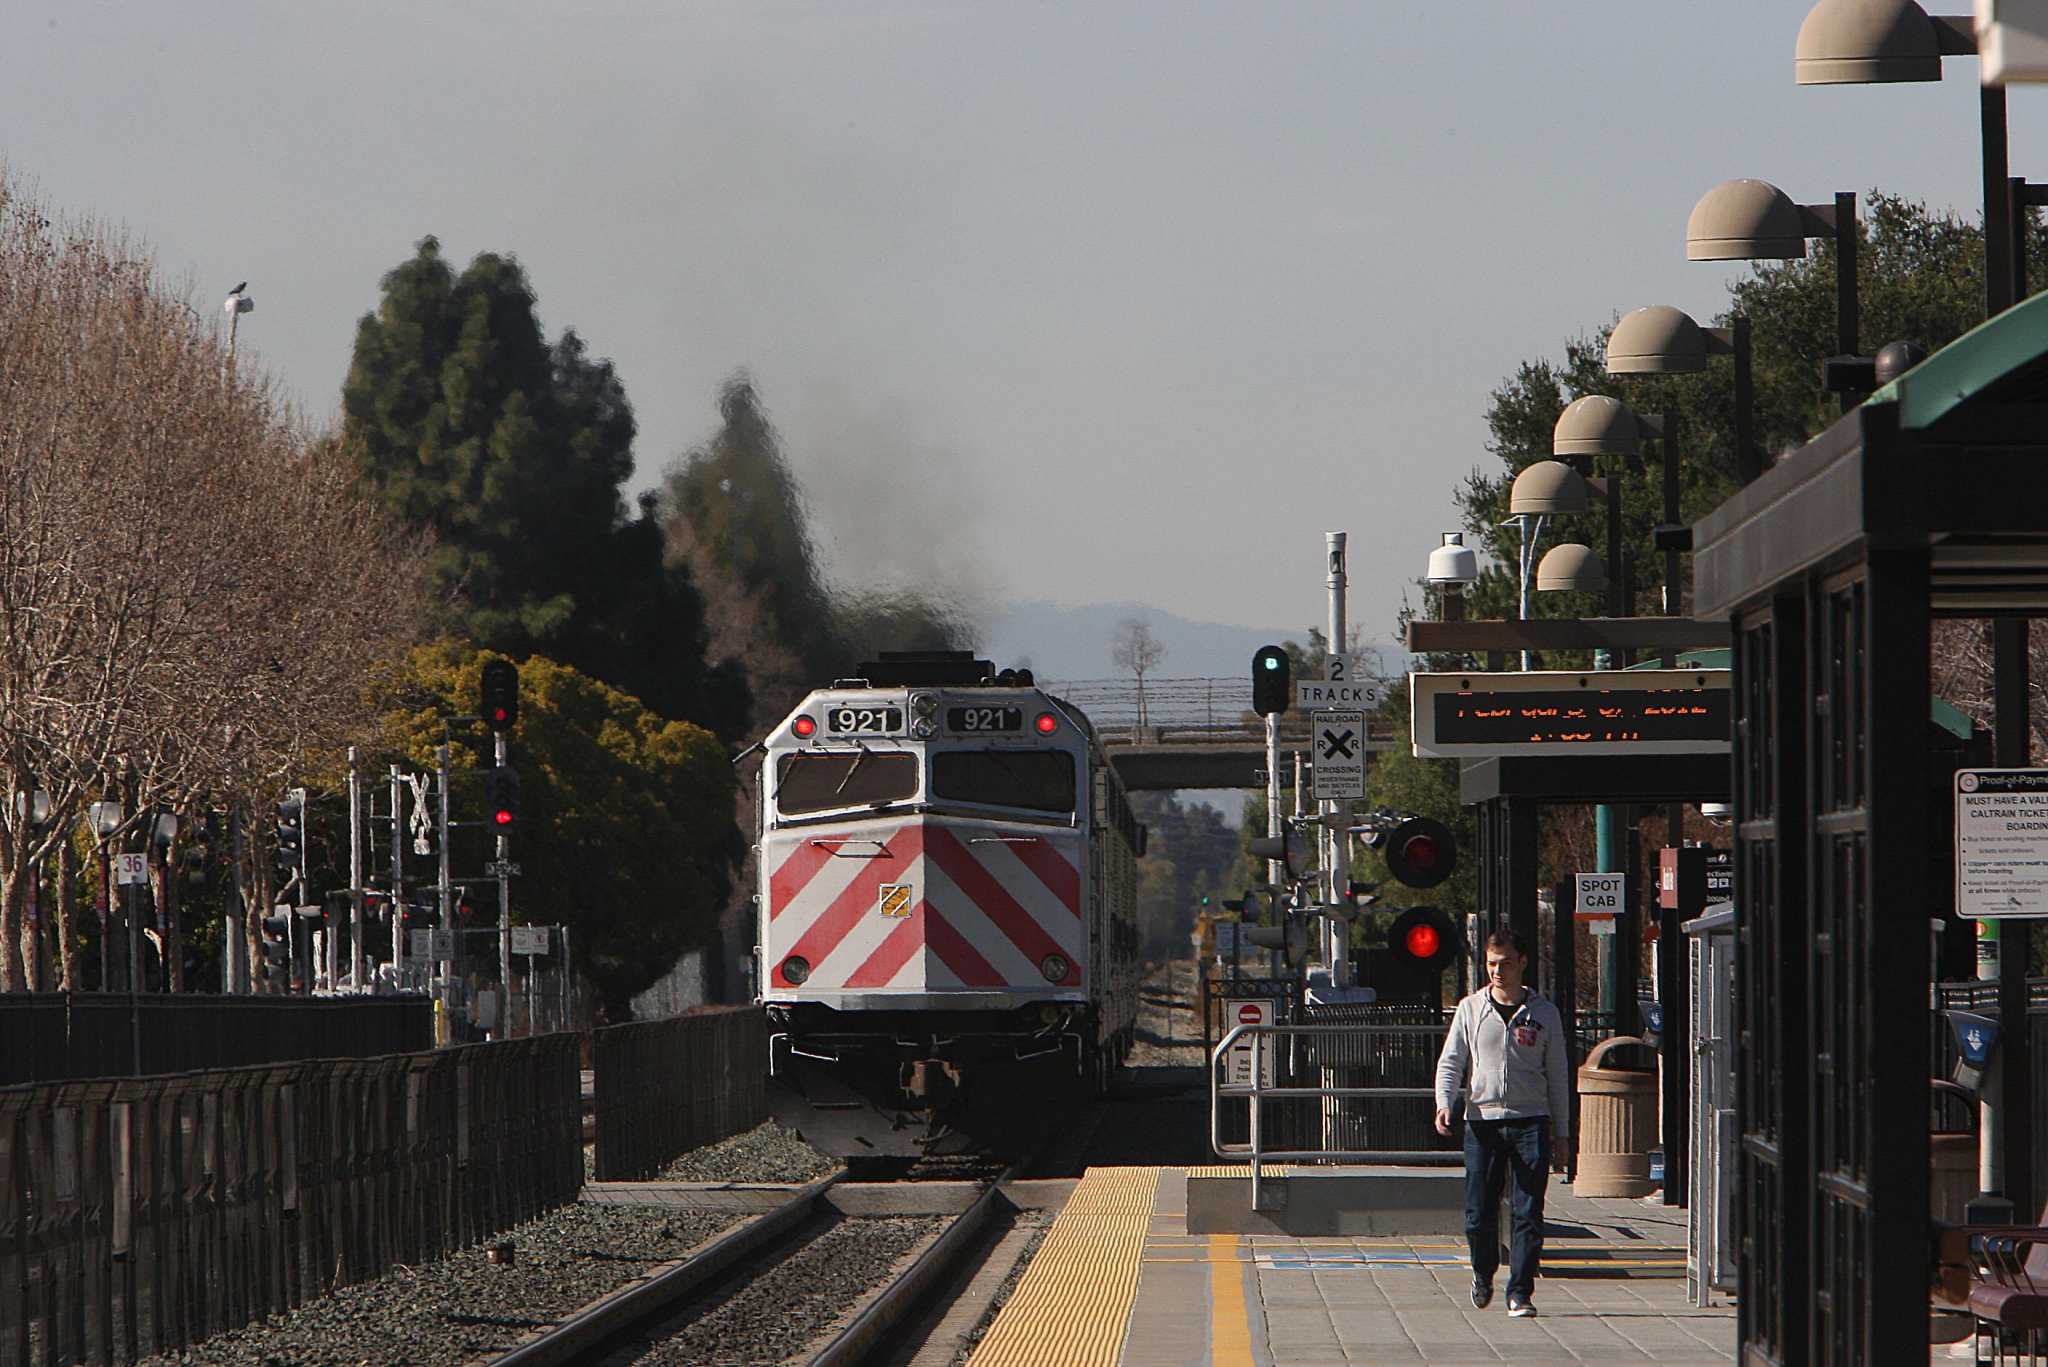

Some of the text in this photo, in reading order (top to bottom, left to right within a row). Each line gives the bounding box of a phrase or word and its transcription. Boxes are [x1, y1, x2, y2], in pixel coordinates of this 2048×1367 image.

[1331, 661, 1345, 681] 2
[1301, 687, 1376, 701] TRACKS
[838, 709, 888, 733] 921
[964, 708, 1004, 731] 921
[1316, 714, 1361, 722] RAILROAD
[1316, 766, 1361, 774] CROSSING
[1966, 797, 1991, 805] MUST
[1994, 796, 2018, 805] HAVE
[2019, 796, 2028, 804] A
[1970, 809, 2016, 818] CALTRAIN
[123, 855, 143, 873] 36
[1581, 879, 1621, 892] SPOT
[1586, 895, 1616, 907] CAB
